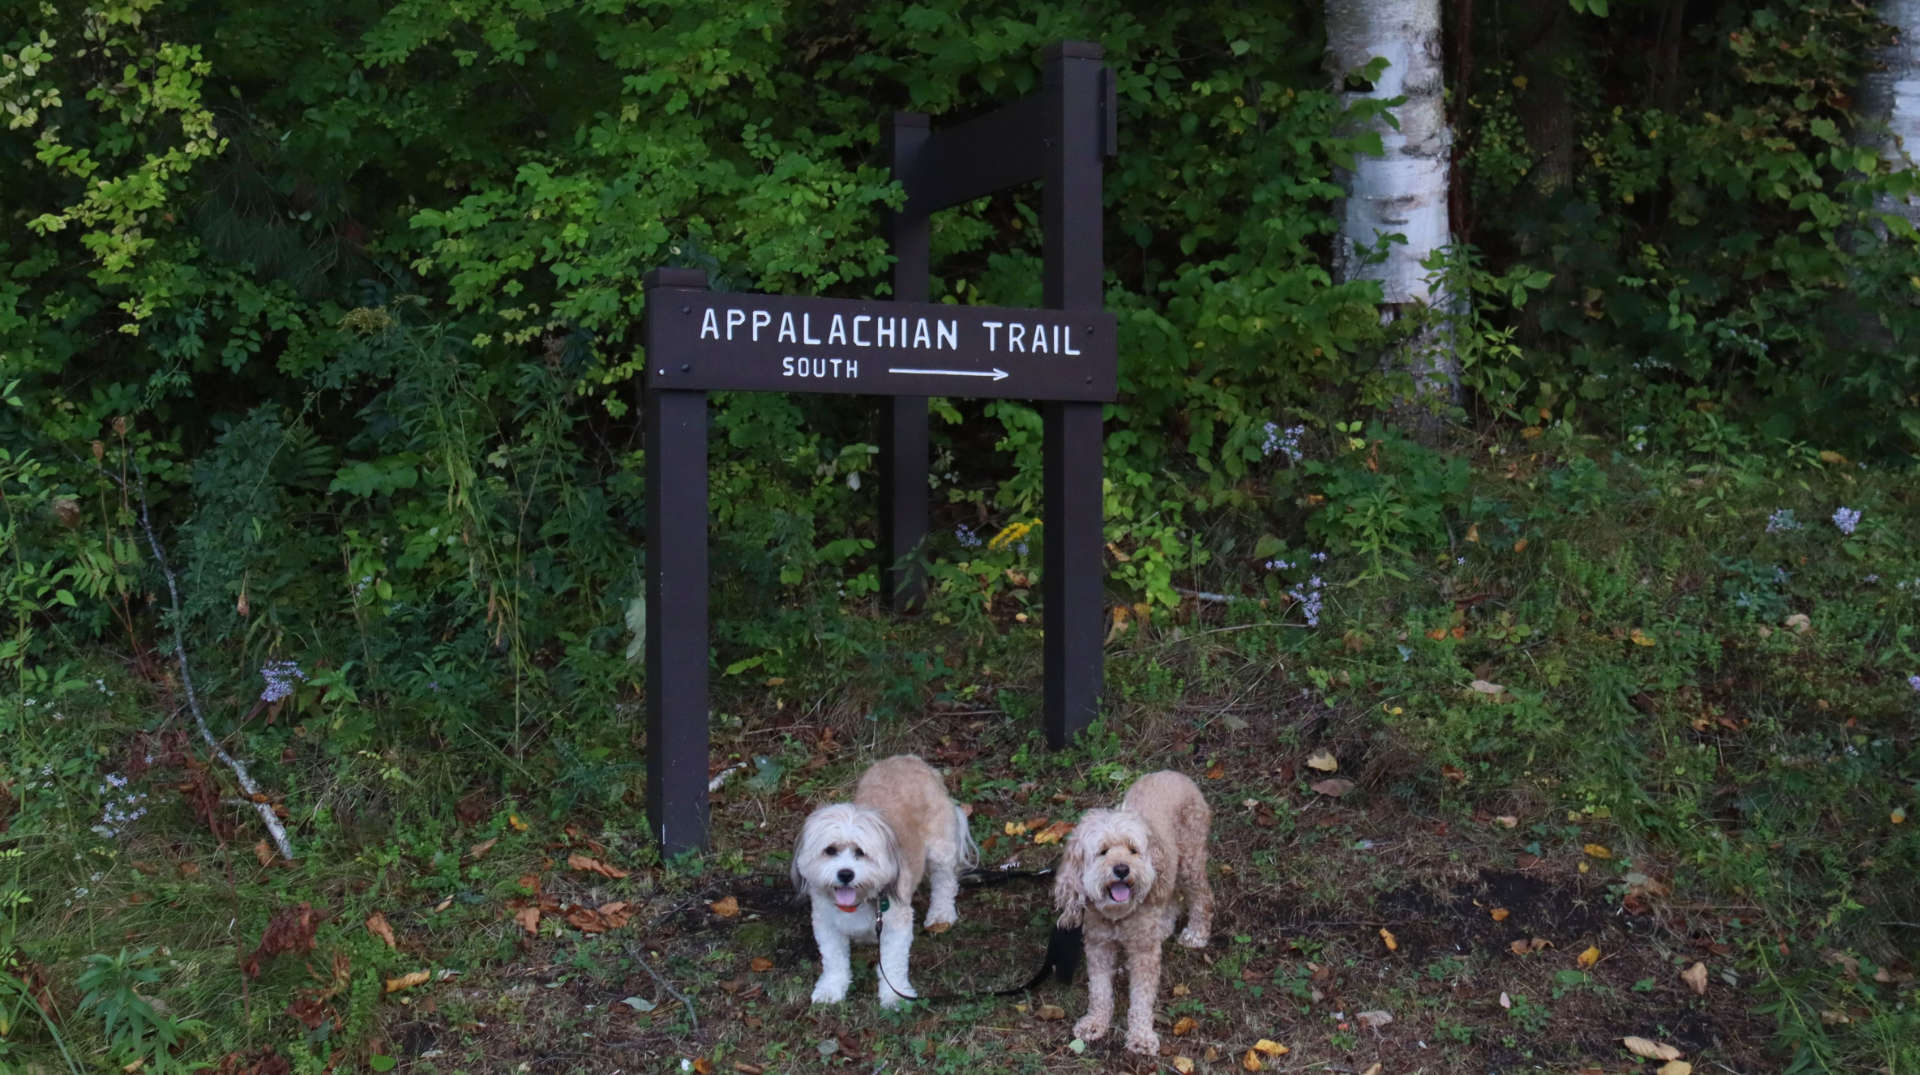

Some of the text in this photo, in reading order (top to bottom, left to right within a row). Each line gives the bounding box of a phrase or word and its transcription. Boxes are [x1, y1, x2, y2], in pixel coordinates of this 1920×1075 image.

[699, 307, 1082, 357] APPALACHIAN TRAIL
[781, 356, 858, 379] SOUTH
